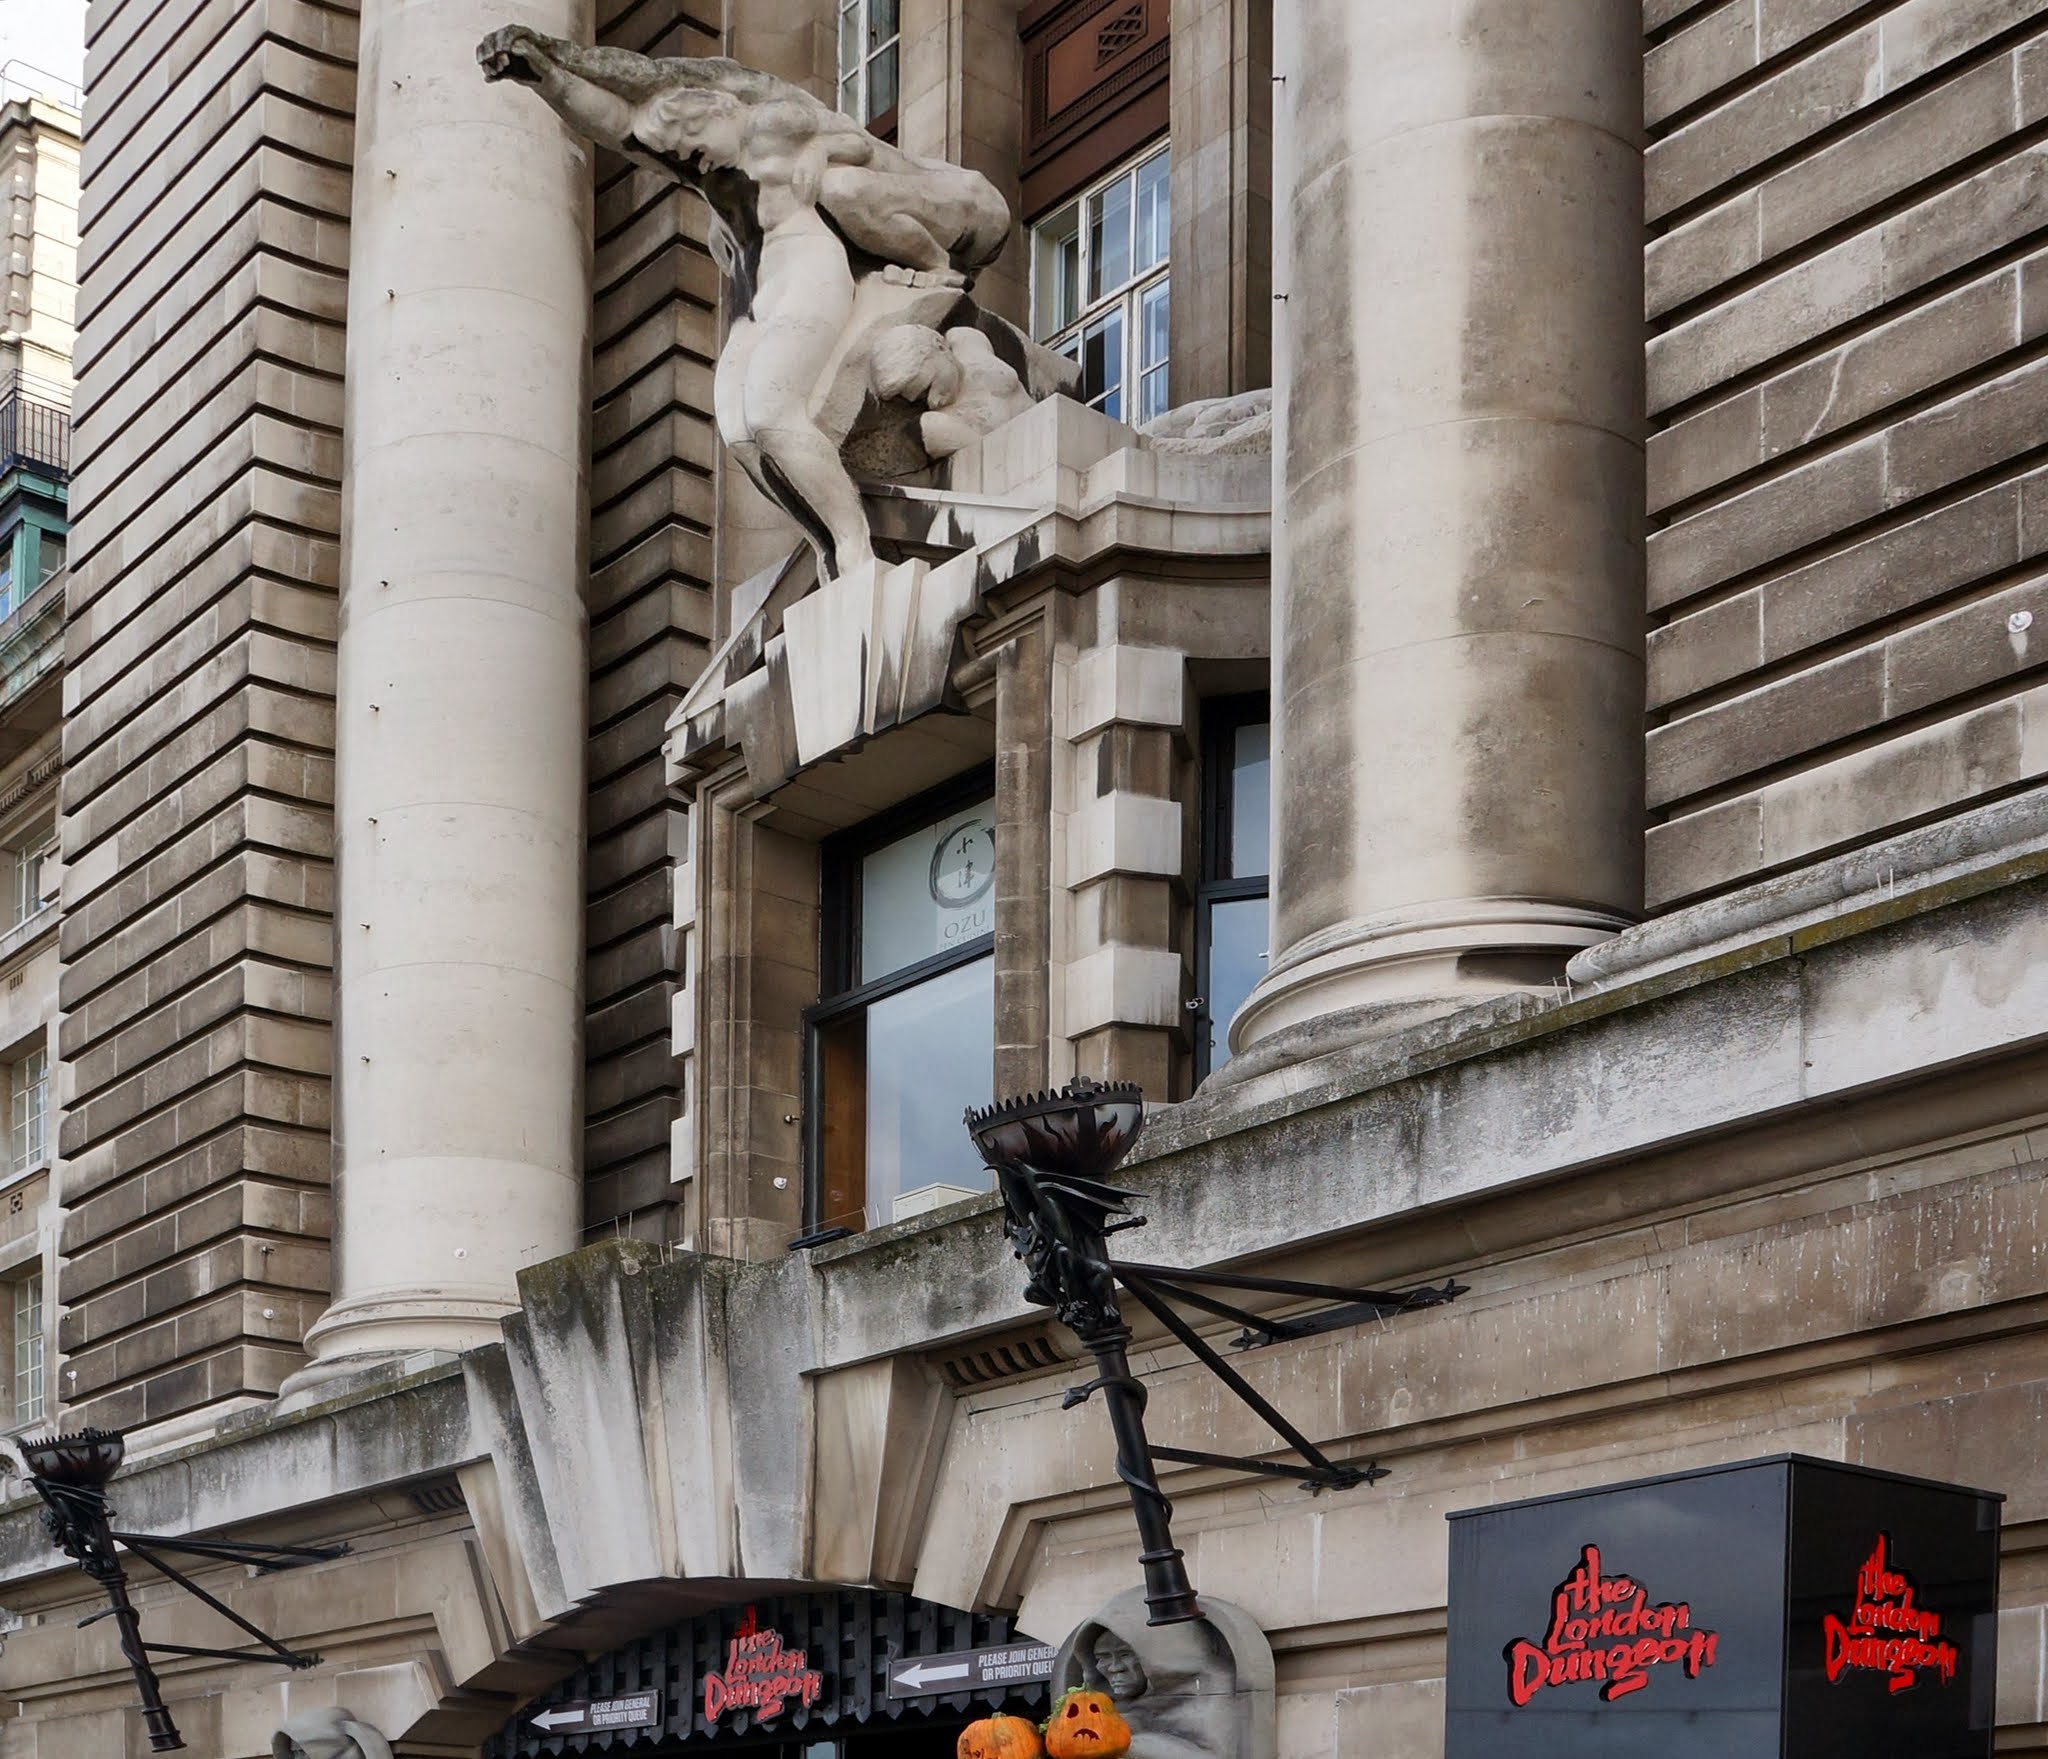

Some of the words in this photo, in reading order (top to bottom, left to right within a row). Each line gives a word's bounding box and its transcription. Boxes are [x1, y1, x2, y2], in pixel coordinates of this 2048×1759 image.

[944, 909, 985, 938] OZU
[1564, 1546, 1637, 1614] the
[1861, 1533, 1907, 1601] the
[1548, 1589, 1690, 1655] London
[1848, 1572, 1941, 1642] London
[724, 1636, 805, 1684] London
[978, 1652, 1007, 1667] PLEASE
[1008, 1649, 1026, 1663] JOIN
[982, 1668, 994, 1681] OR
[995, 1663, 1032, 1680] PRIORITY
[1511, 1630, 1720, 1706] Dungeon
[1823, 1613, 1957, 1693] Dungeon
[590, 1701, 612, 1714] PLEASE
[611, 1700, 625, 1711] JOIN
[625, 1697, 651, 1710] GENERAL
[593, 1714, 601, 1725] OR
[602, 1711, 627, 1725] PRIORITY
[628, 1709, 648, 1722] QUEUE
[703, 1672, 822, 1722] Dungeon
